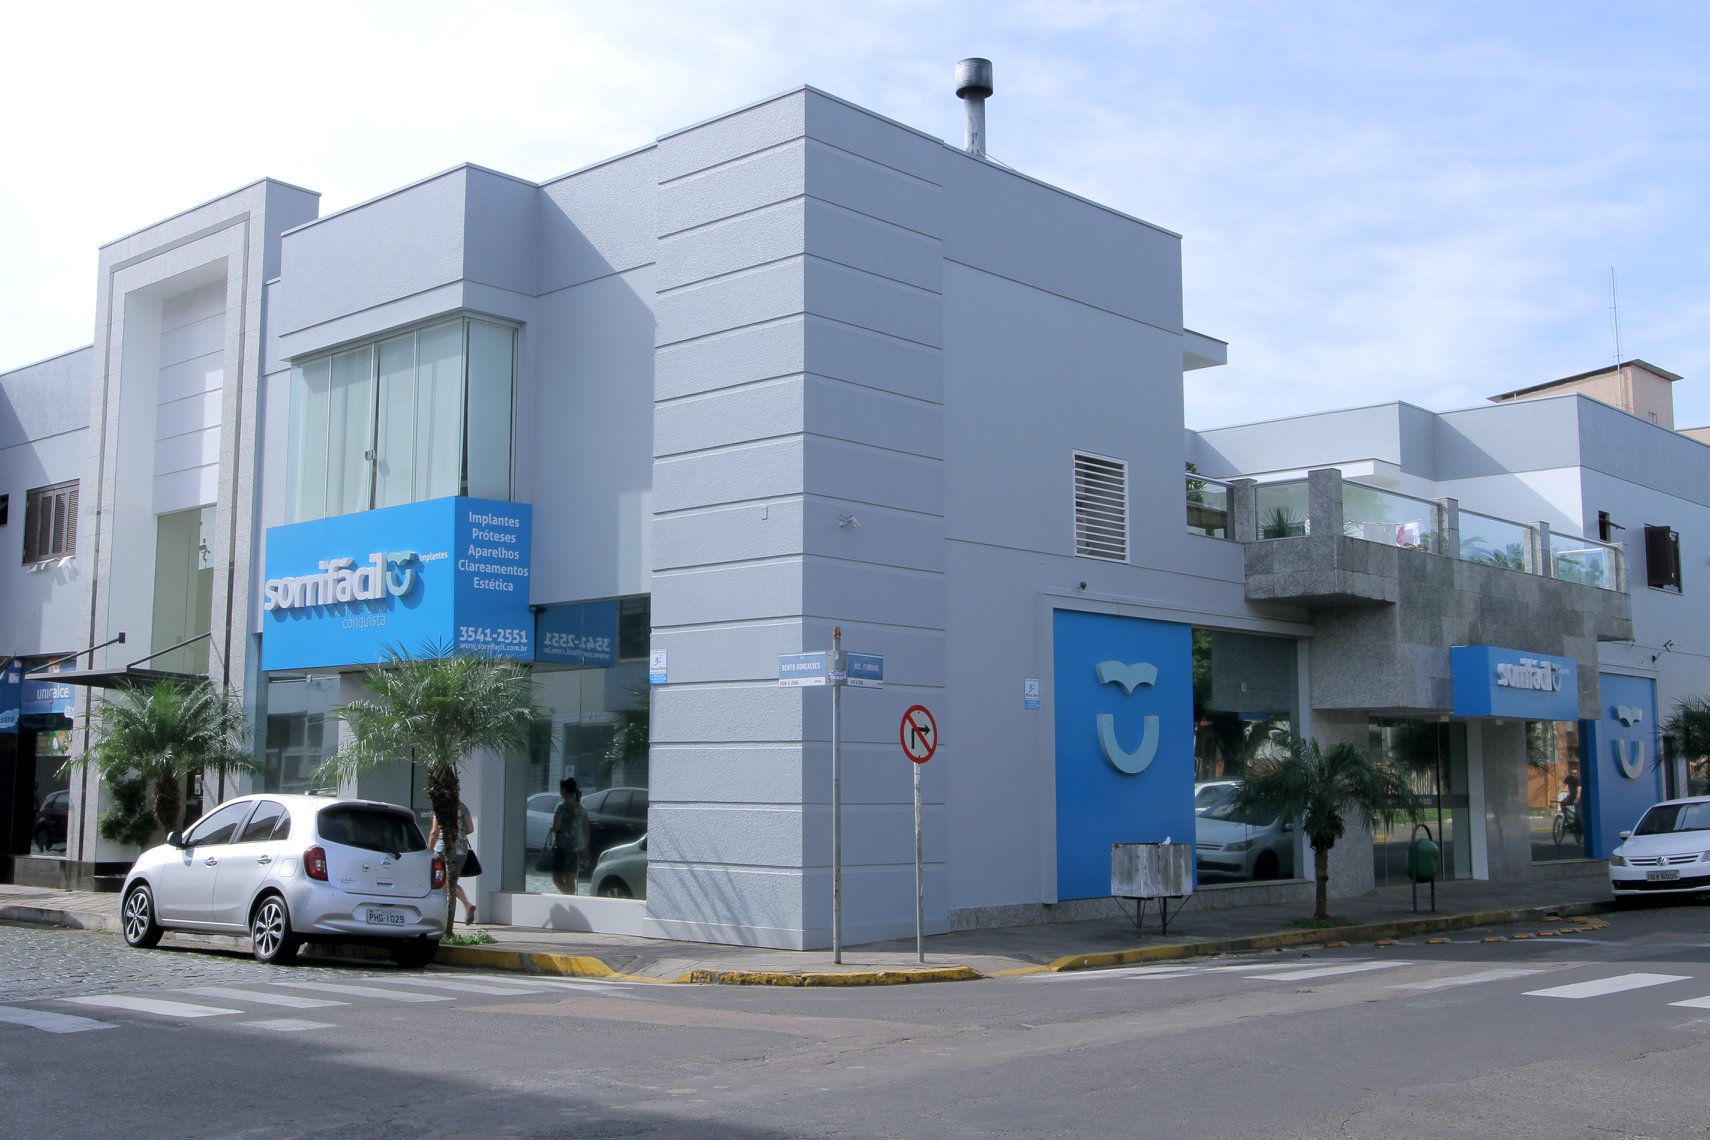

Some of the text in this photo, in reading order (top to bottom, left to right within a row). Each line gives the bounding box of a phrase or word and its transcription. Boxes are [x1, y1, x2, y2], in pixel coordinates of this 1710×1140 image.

[469, 512, 520, 528] Implantes
[472, 528, 516, 543] Próteses
[468, 544, 520, 560] Aparelhos
[458, 559, 529, 577] Clareamentos
[473, 577, 514, 591] Estética
[342, 613, 386, 631] conquista
[459, 626, 528, 643] 3541-2551
